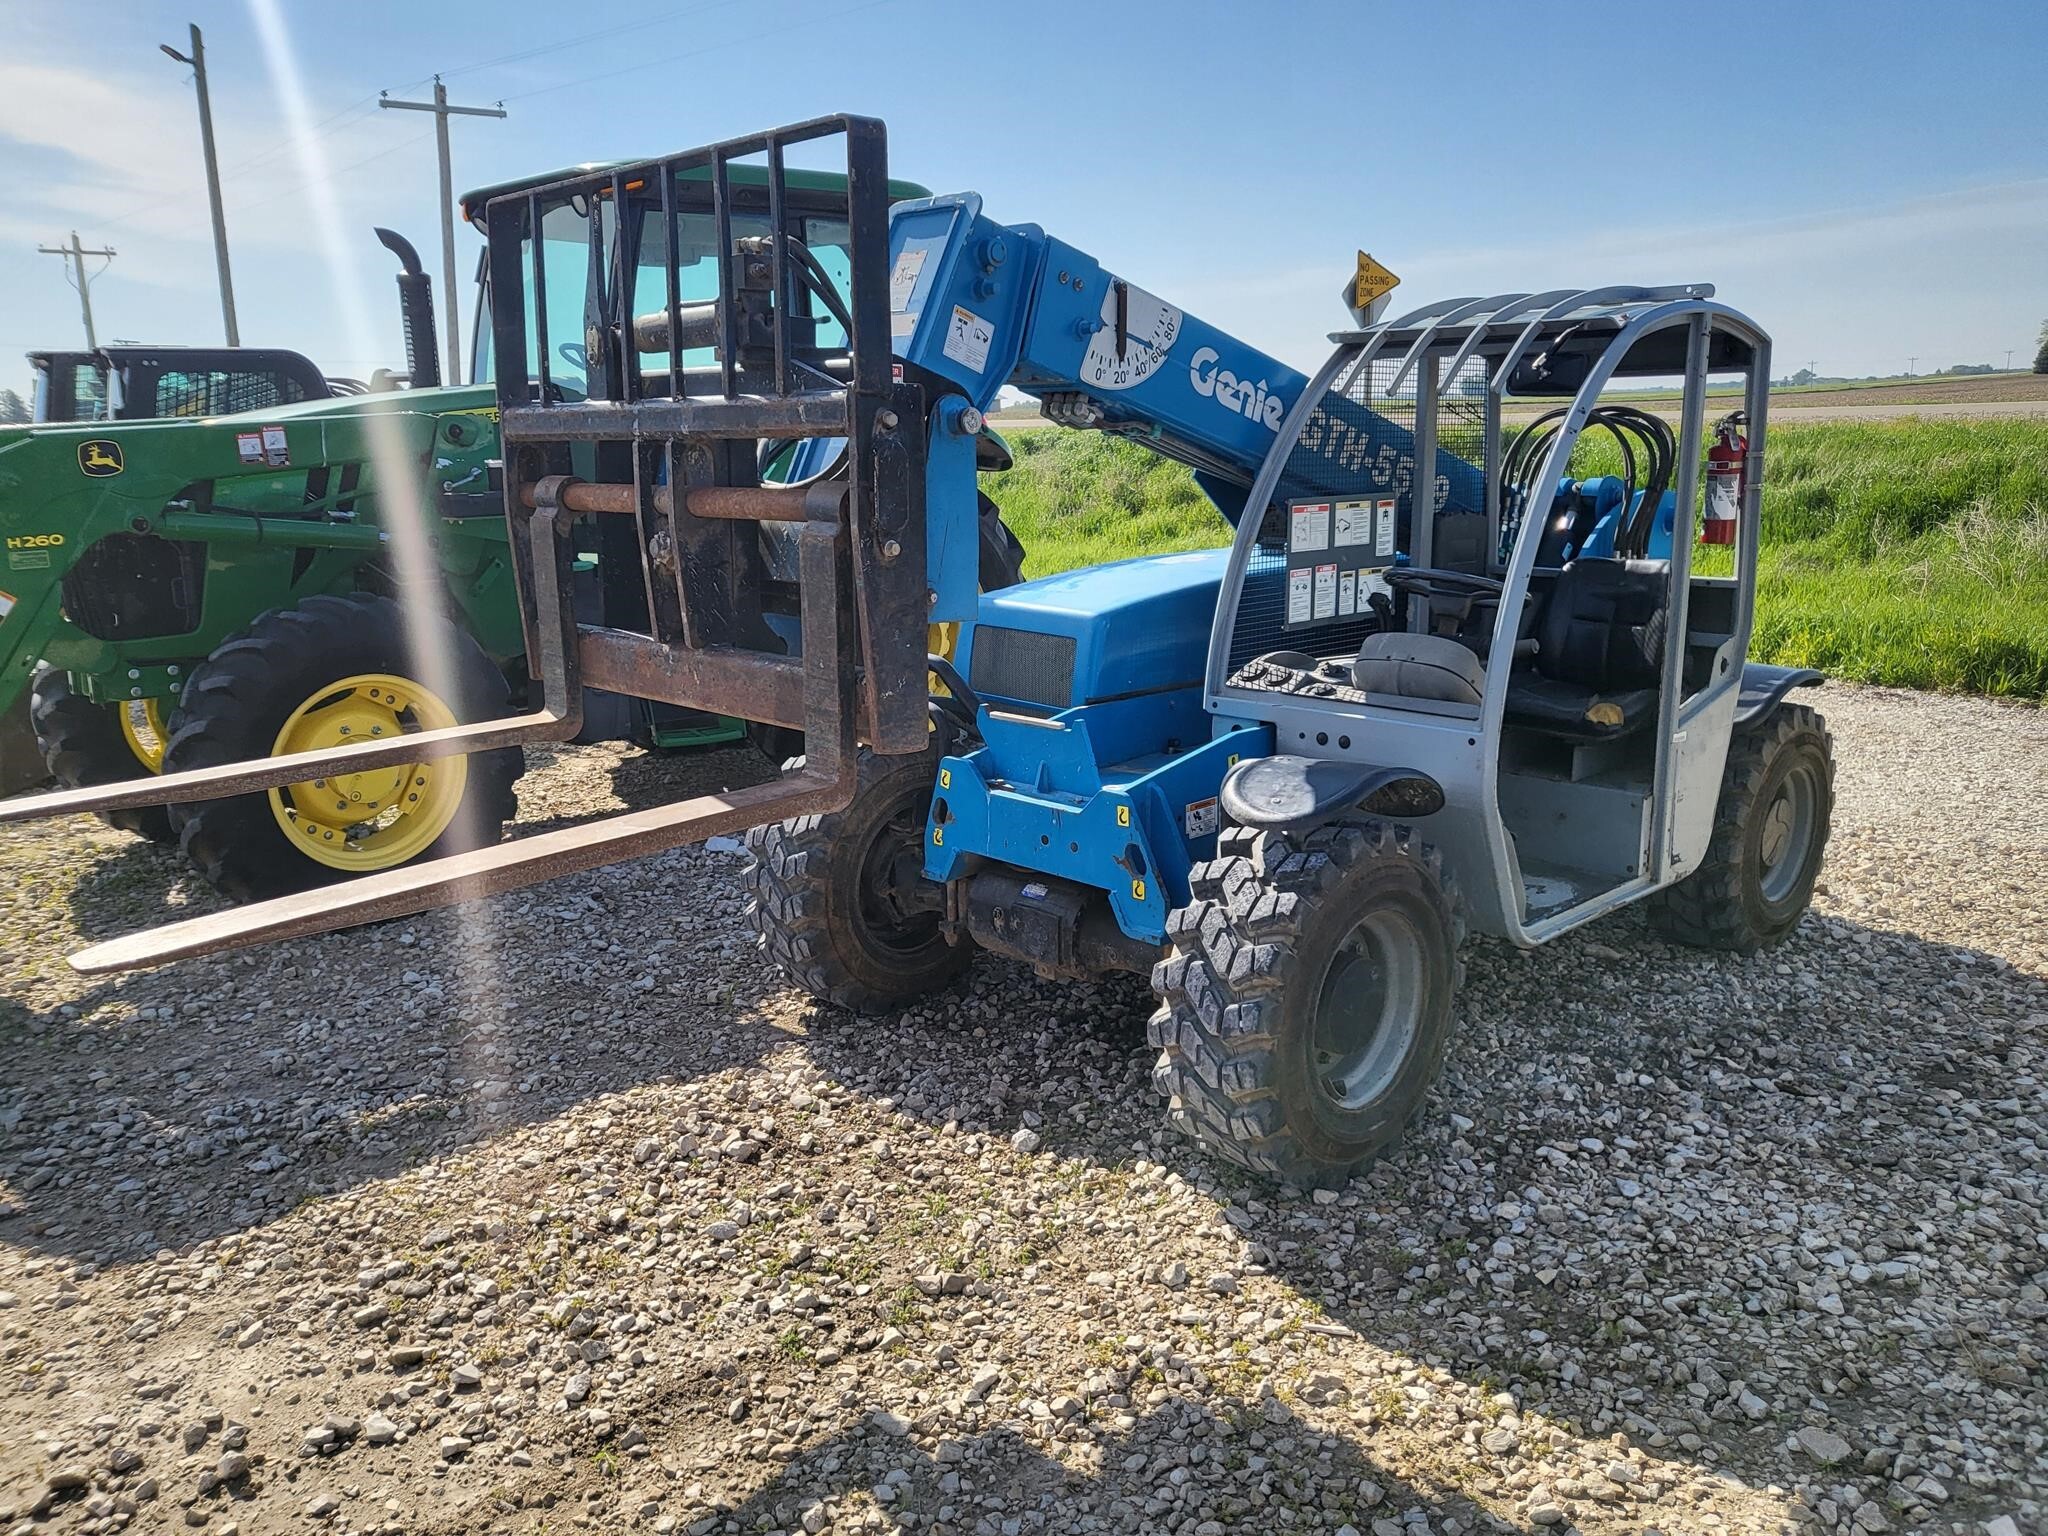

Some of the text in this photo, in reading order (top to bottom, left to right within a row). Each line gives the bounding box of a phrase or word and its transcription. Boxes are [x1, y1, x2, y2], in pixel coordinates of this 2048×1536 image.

[1360, 262, 1370, 273] NO
[1360, 274, 1390, 286] PASSING
[1360, 287, 1374, 298] ZONE
[1190, 346, 1284, 433] Genie
[1300, 405, 1450, 514] GTH-559
[7, 534, 64, 549] H260
